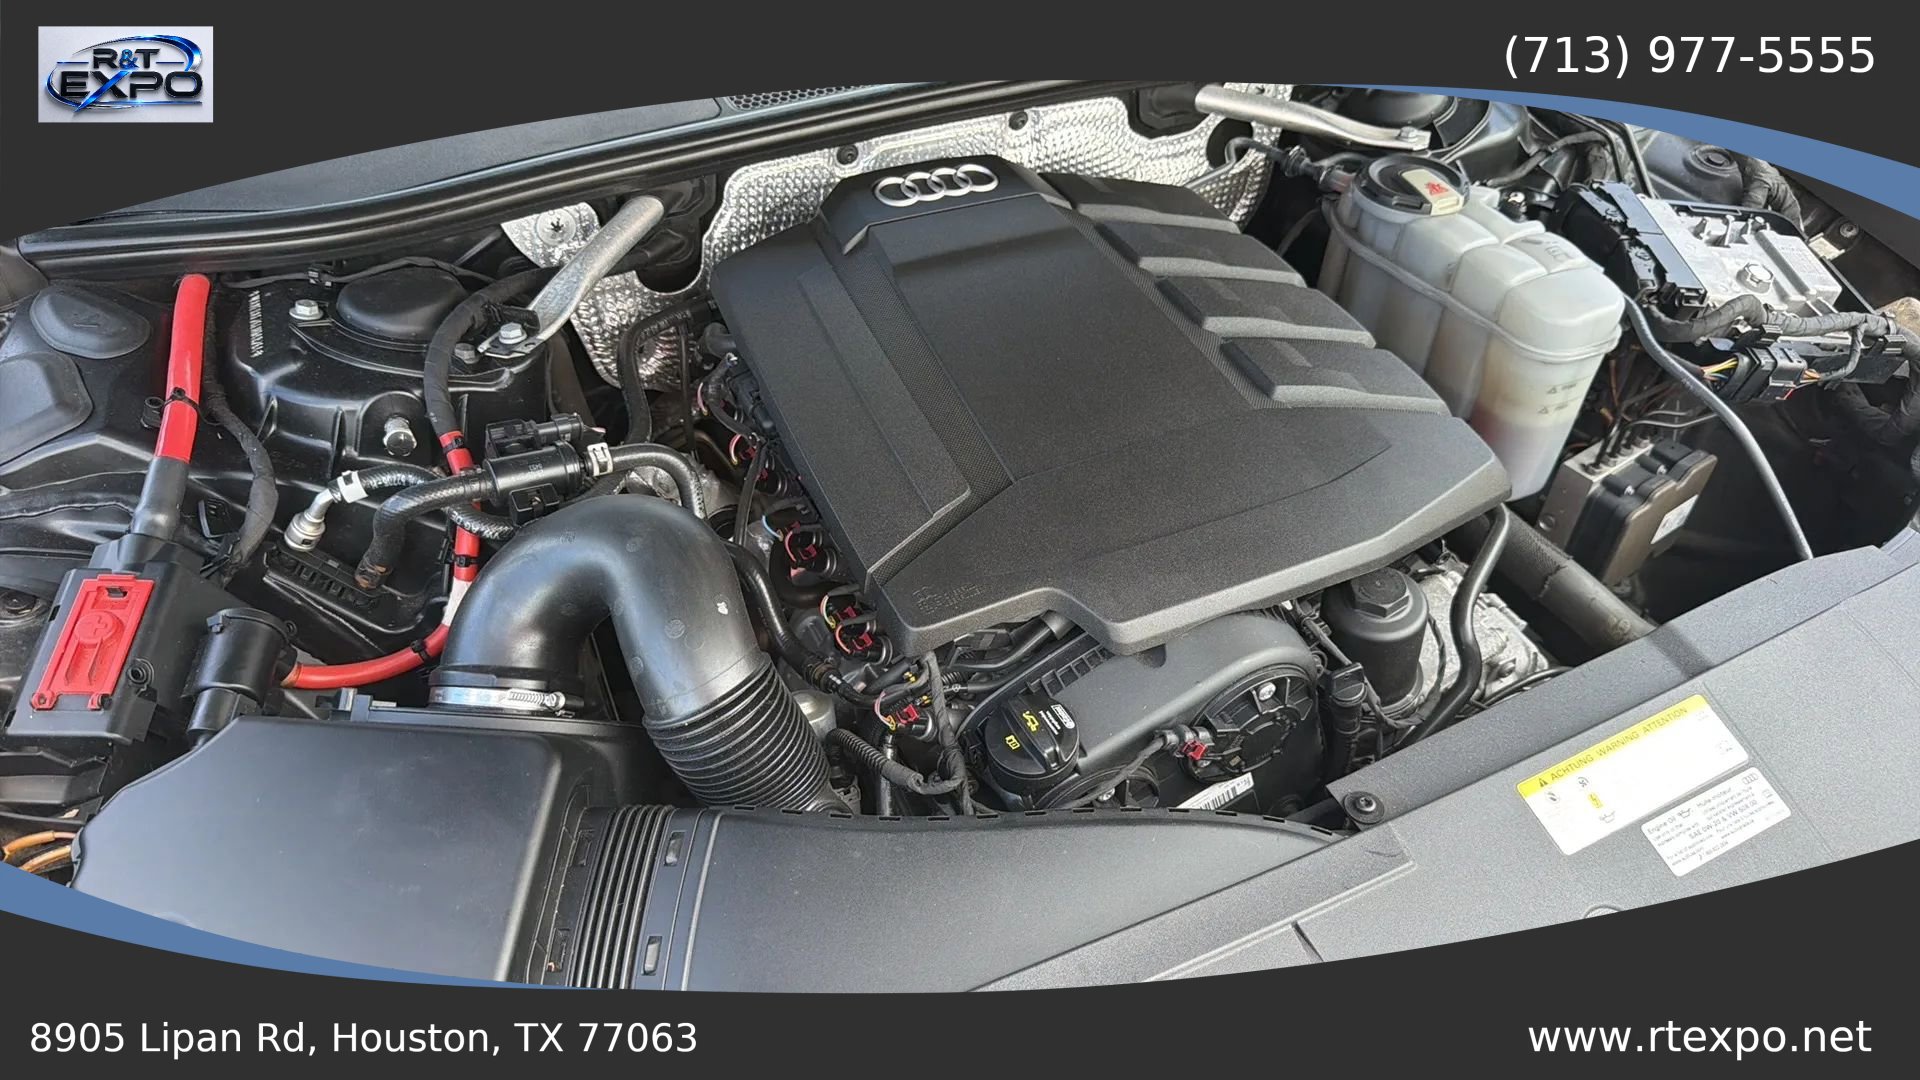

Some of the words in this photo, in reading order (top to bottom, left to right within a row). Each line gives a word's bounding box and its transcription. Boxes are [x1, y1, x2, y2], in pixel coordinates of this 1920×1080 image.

[1549, 753, 1594, 781] ACHTUNG
[1598, 731, 1639, 755] WARNING
[1642, 707, 1687, 733] ATTENTION
[1647, 821, 1668, 834] Engine
[1666, 815, 1676, 824] Oil
[1688, 829, 1702, 839] SAE
[1727, 809, 1738, 818] VW
